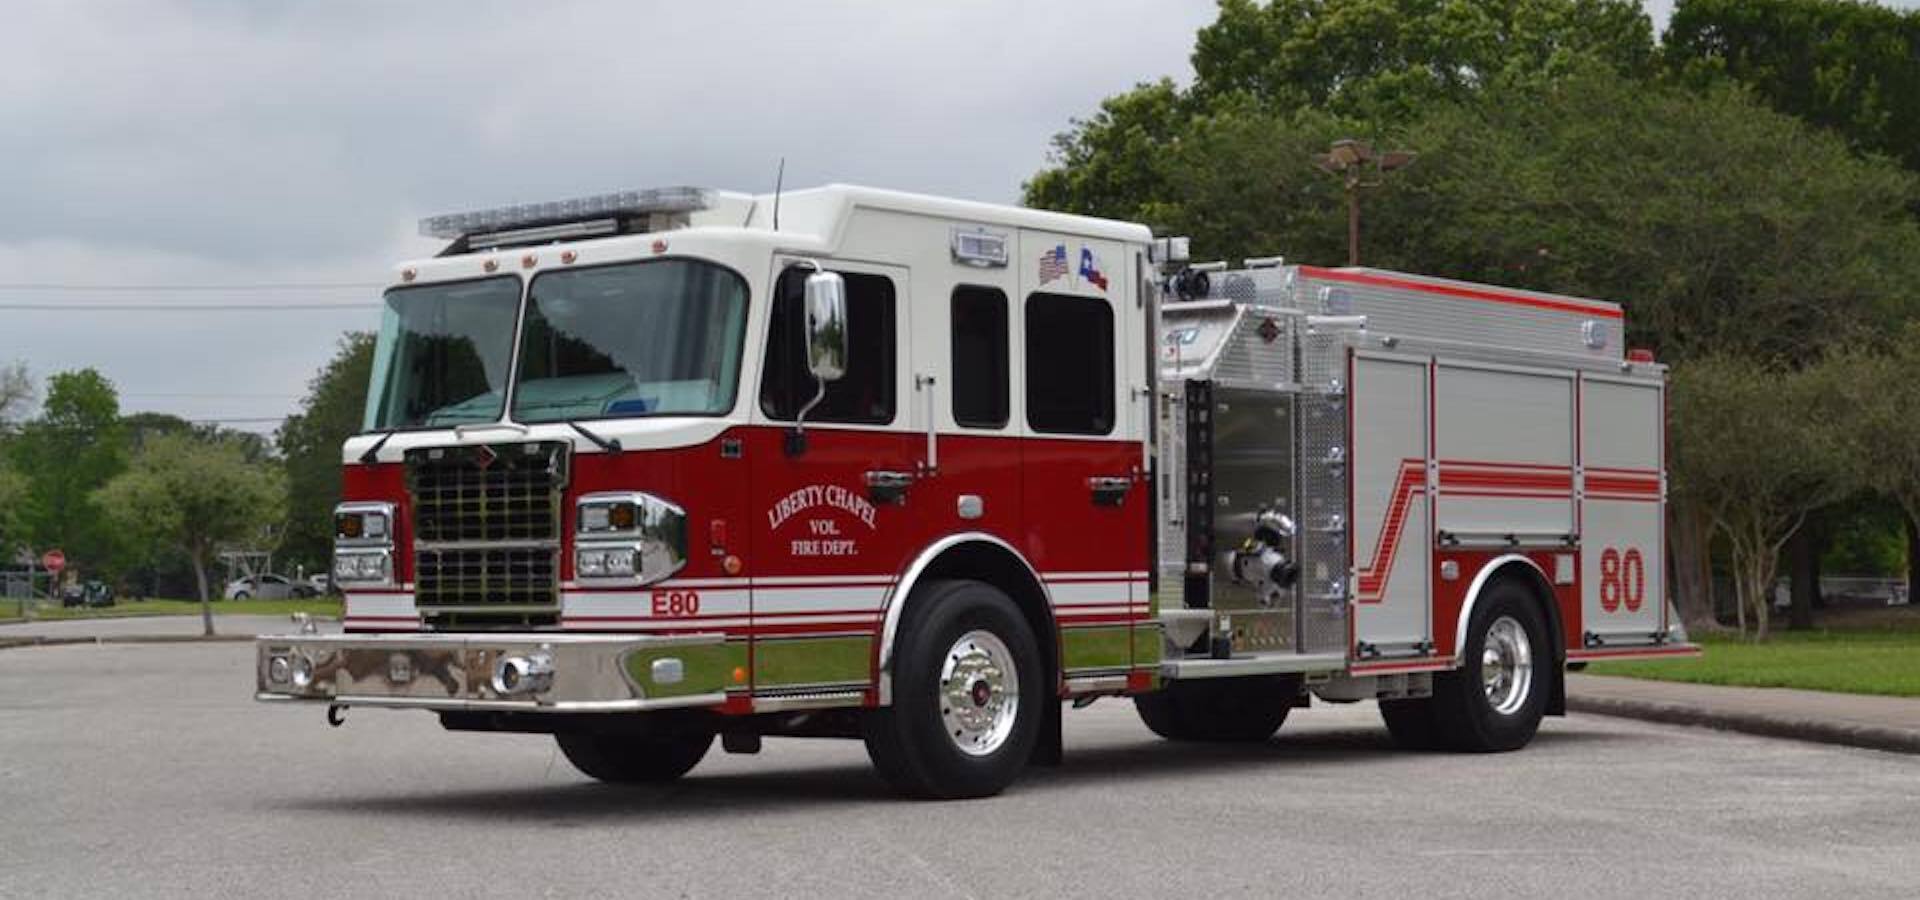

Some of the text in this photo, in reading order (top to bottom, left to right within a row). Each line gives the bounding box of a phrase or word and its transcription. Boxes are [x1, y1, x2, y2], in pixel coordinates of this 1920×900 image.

[768, 484, 876, 530] LIBERTY CHAPEL
[791, 540, 859, 555] FIRE DEPT.
[1601, 547, 1643, 613] 80
[652, 592, 699, 614] E80
